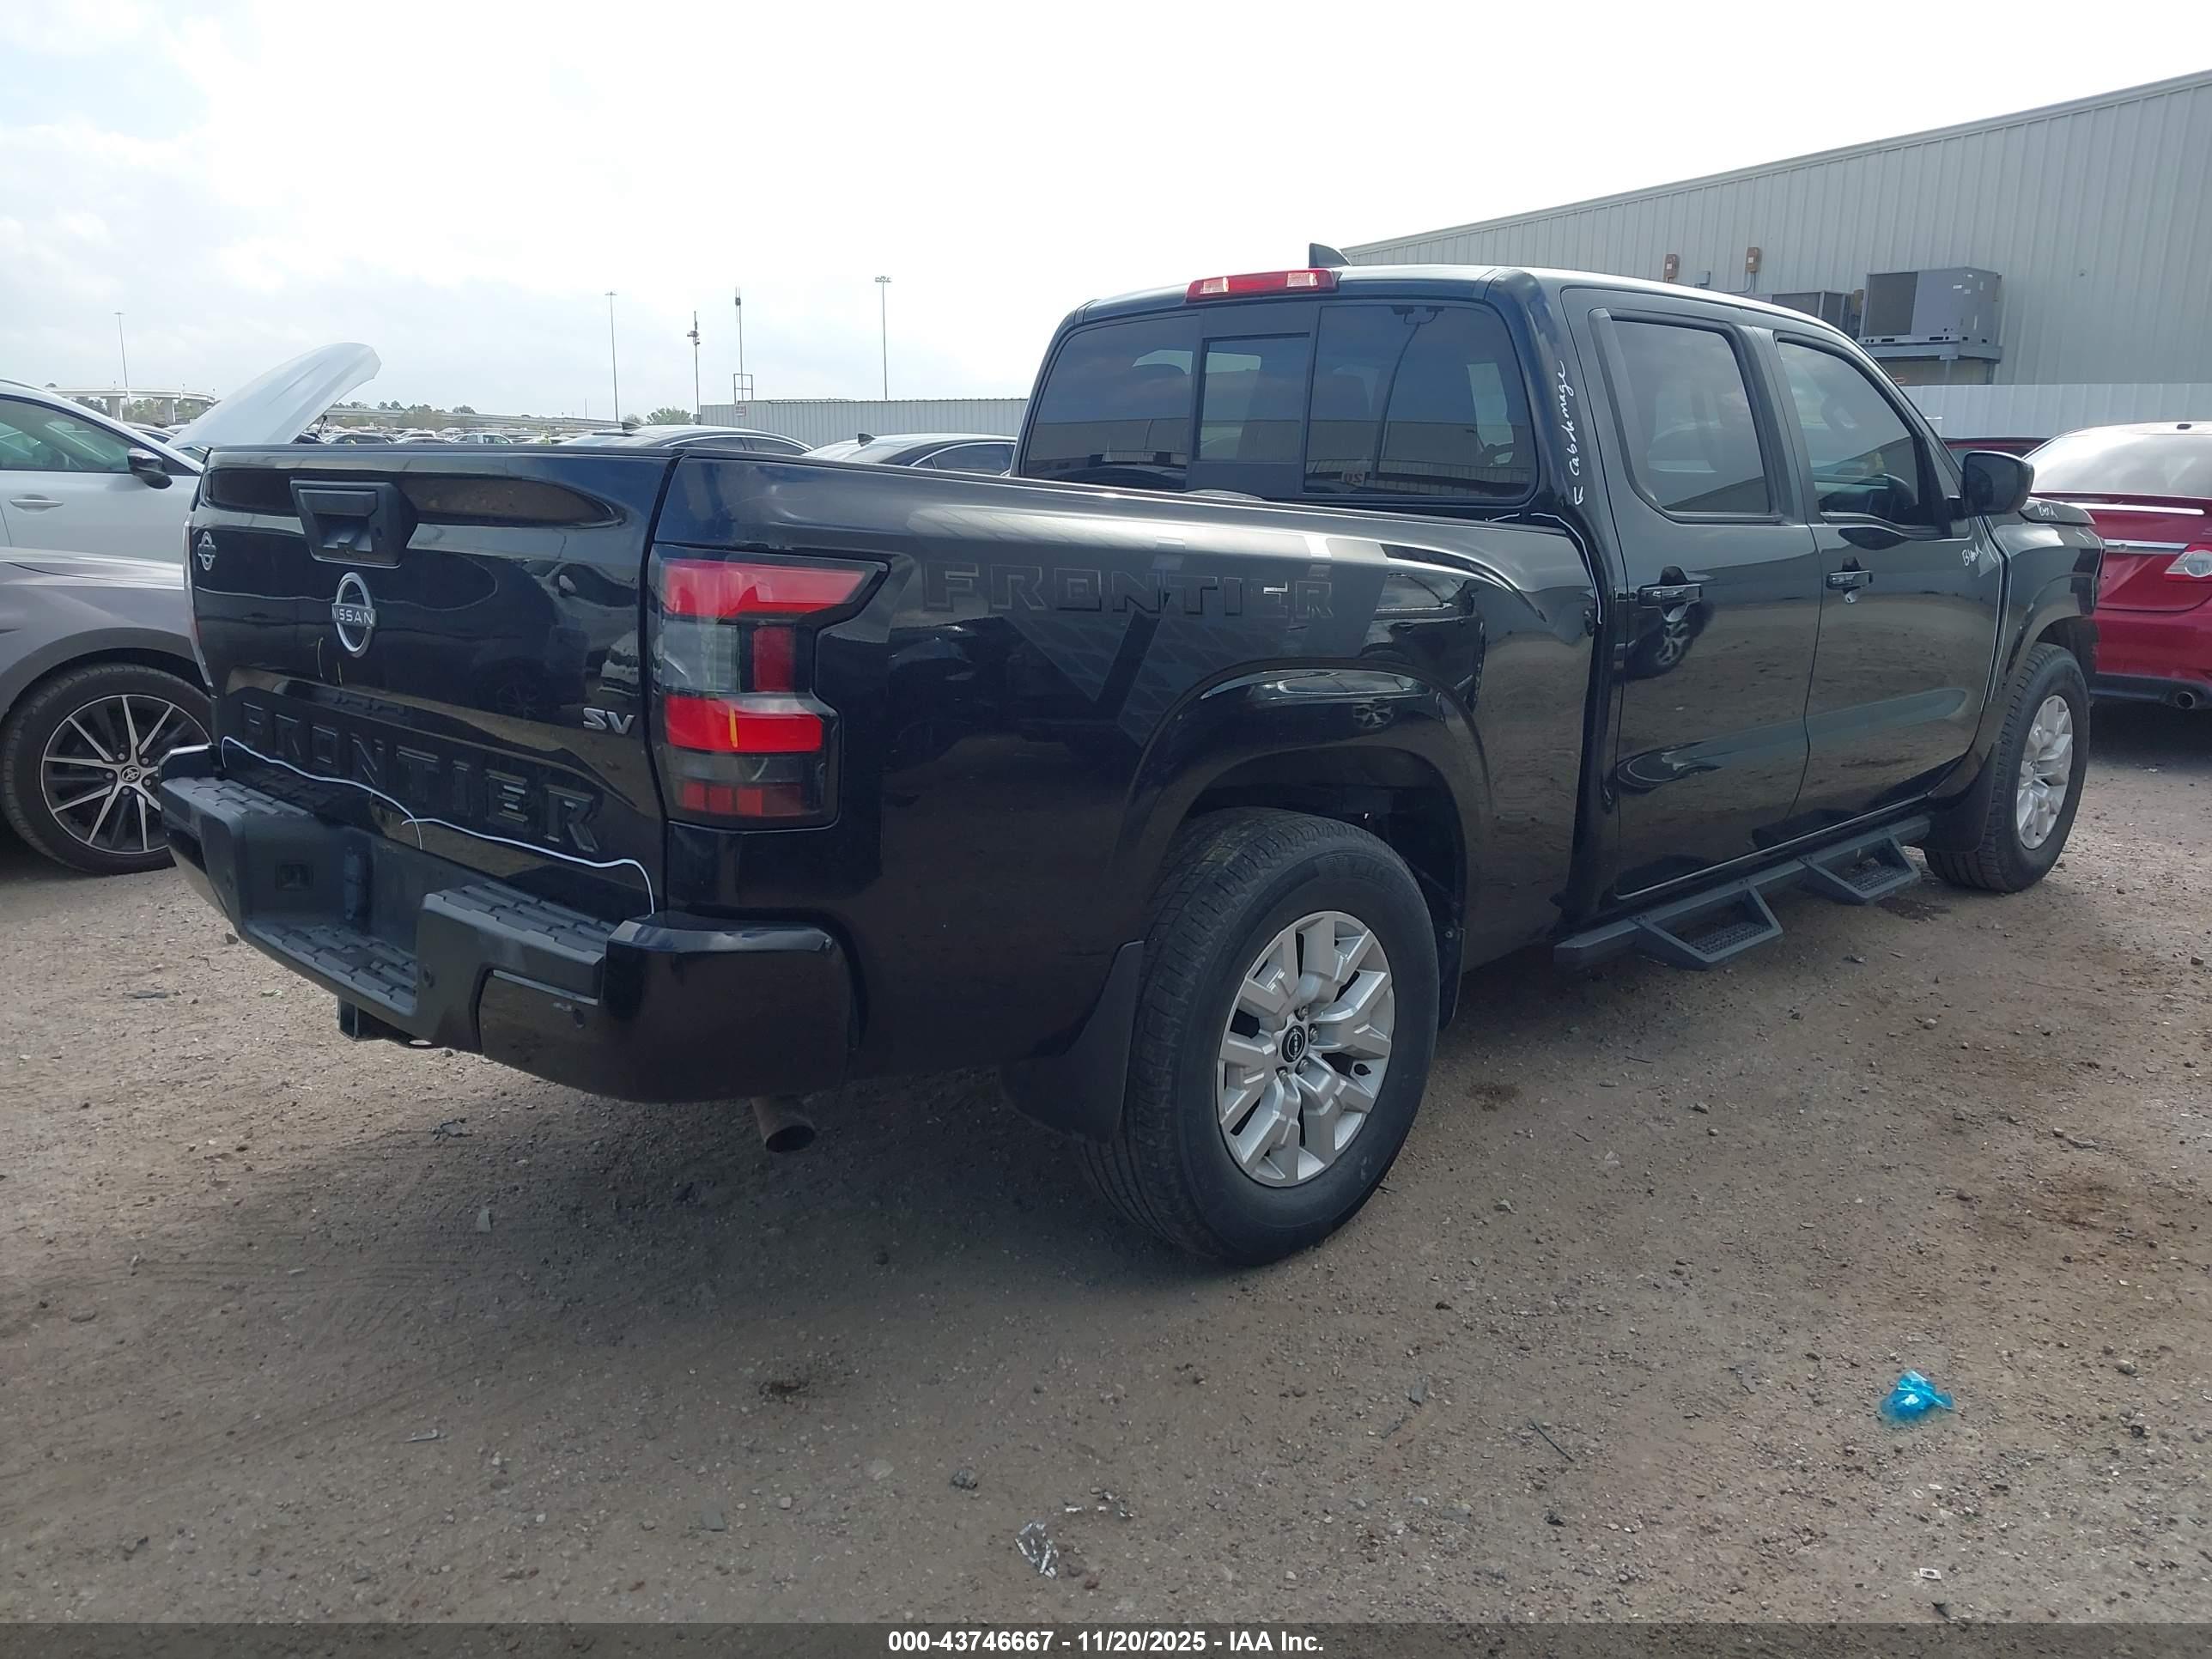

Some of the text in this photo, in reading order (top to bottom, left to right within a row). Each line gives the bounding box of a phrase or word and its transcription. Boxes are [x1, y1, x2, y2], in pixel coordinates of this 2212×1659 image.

[922, 562, 1334, 619] FRONTIER
[331, 604, 374, 625] NISSAN
[583, 707, 635, 735] SV
[241, 702, 599, 853] FRONTIER
